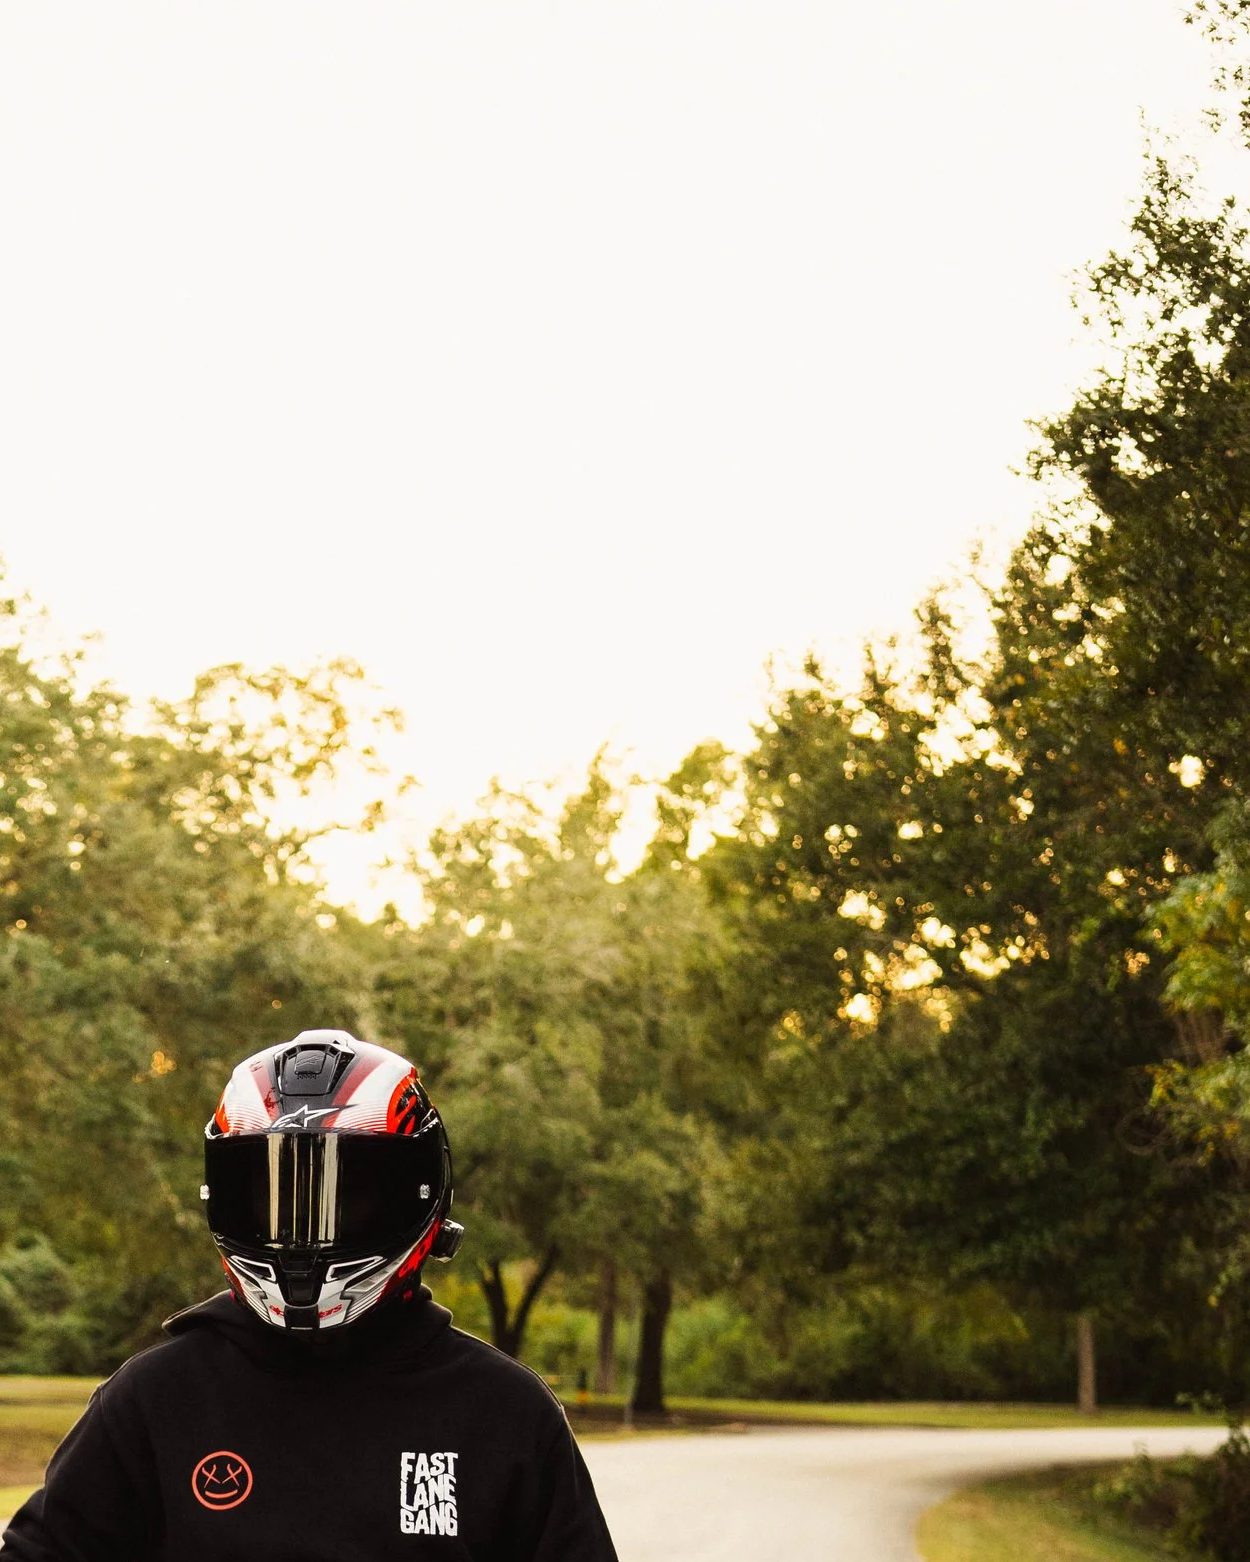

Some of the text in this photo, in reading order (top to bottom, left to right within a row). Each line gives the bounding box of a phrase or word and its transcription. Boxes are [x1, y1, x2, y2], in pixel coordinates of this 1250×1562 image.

[400, 1451, 459, 1484] FAST
[400, 1473, 457, 1512] LANE
[400, 1501, 458, 1537] GANG
